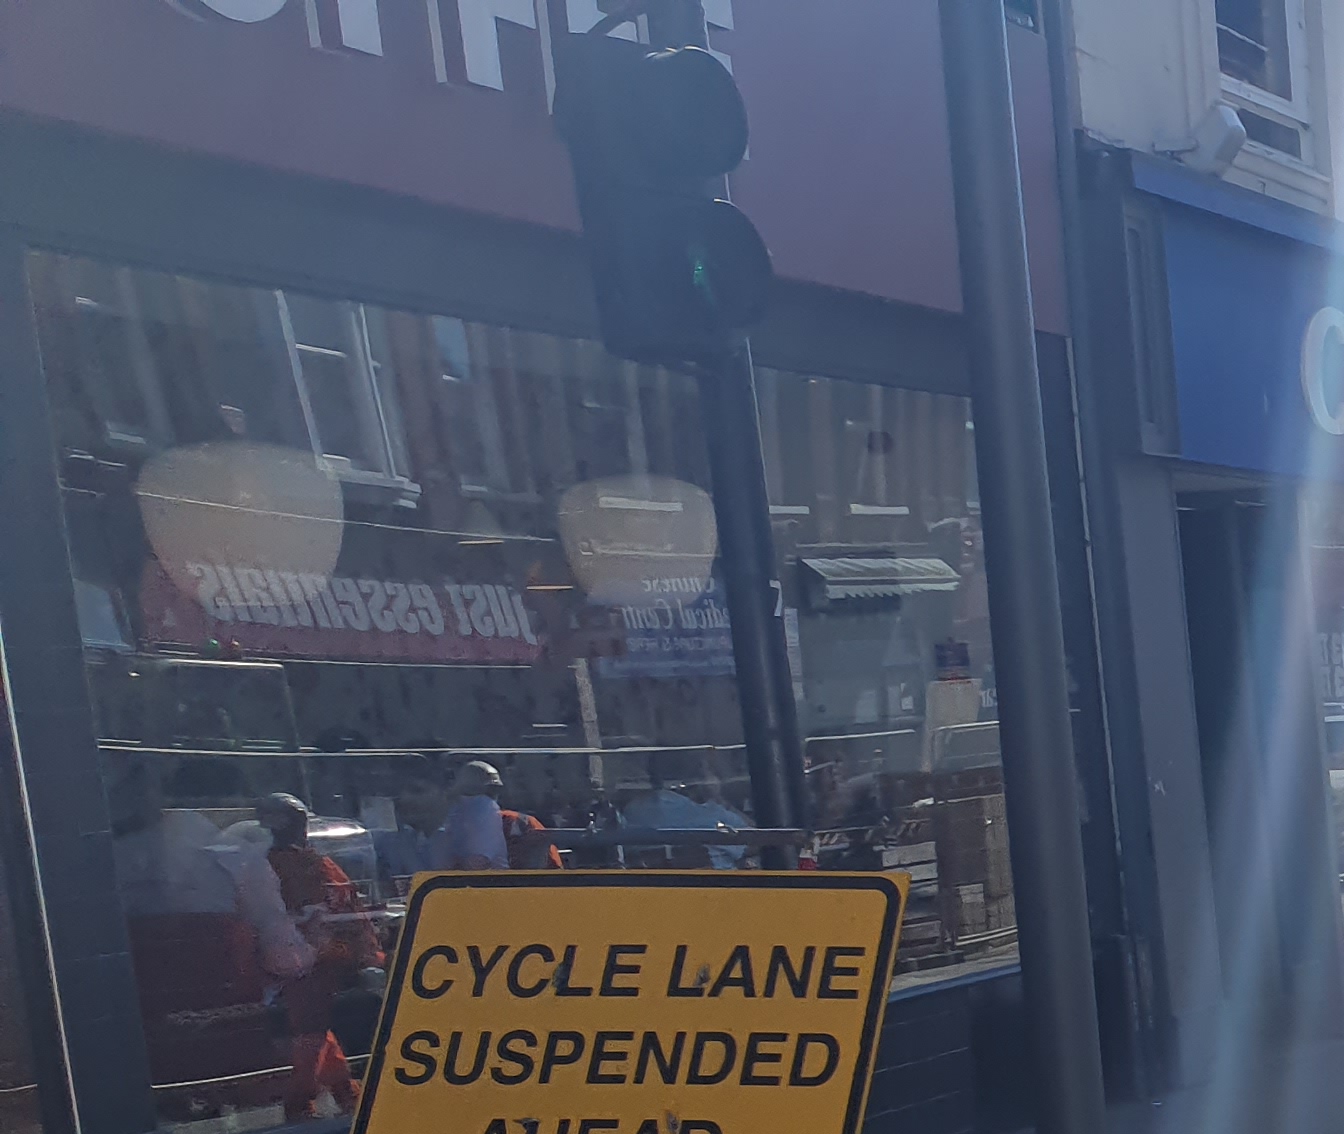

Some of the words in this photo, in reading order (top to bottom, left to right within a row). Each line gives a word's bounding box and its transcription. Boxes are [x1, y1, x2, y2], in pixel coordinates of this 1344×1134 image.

[411, 944, 646, 999] CYCLE
[667, 945, 865, 999] LANE
[394, 1030, 840, 1086] SUSPENDED
